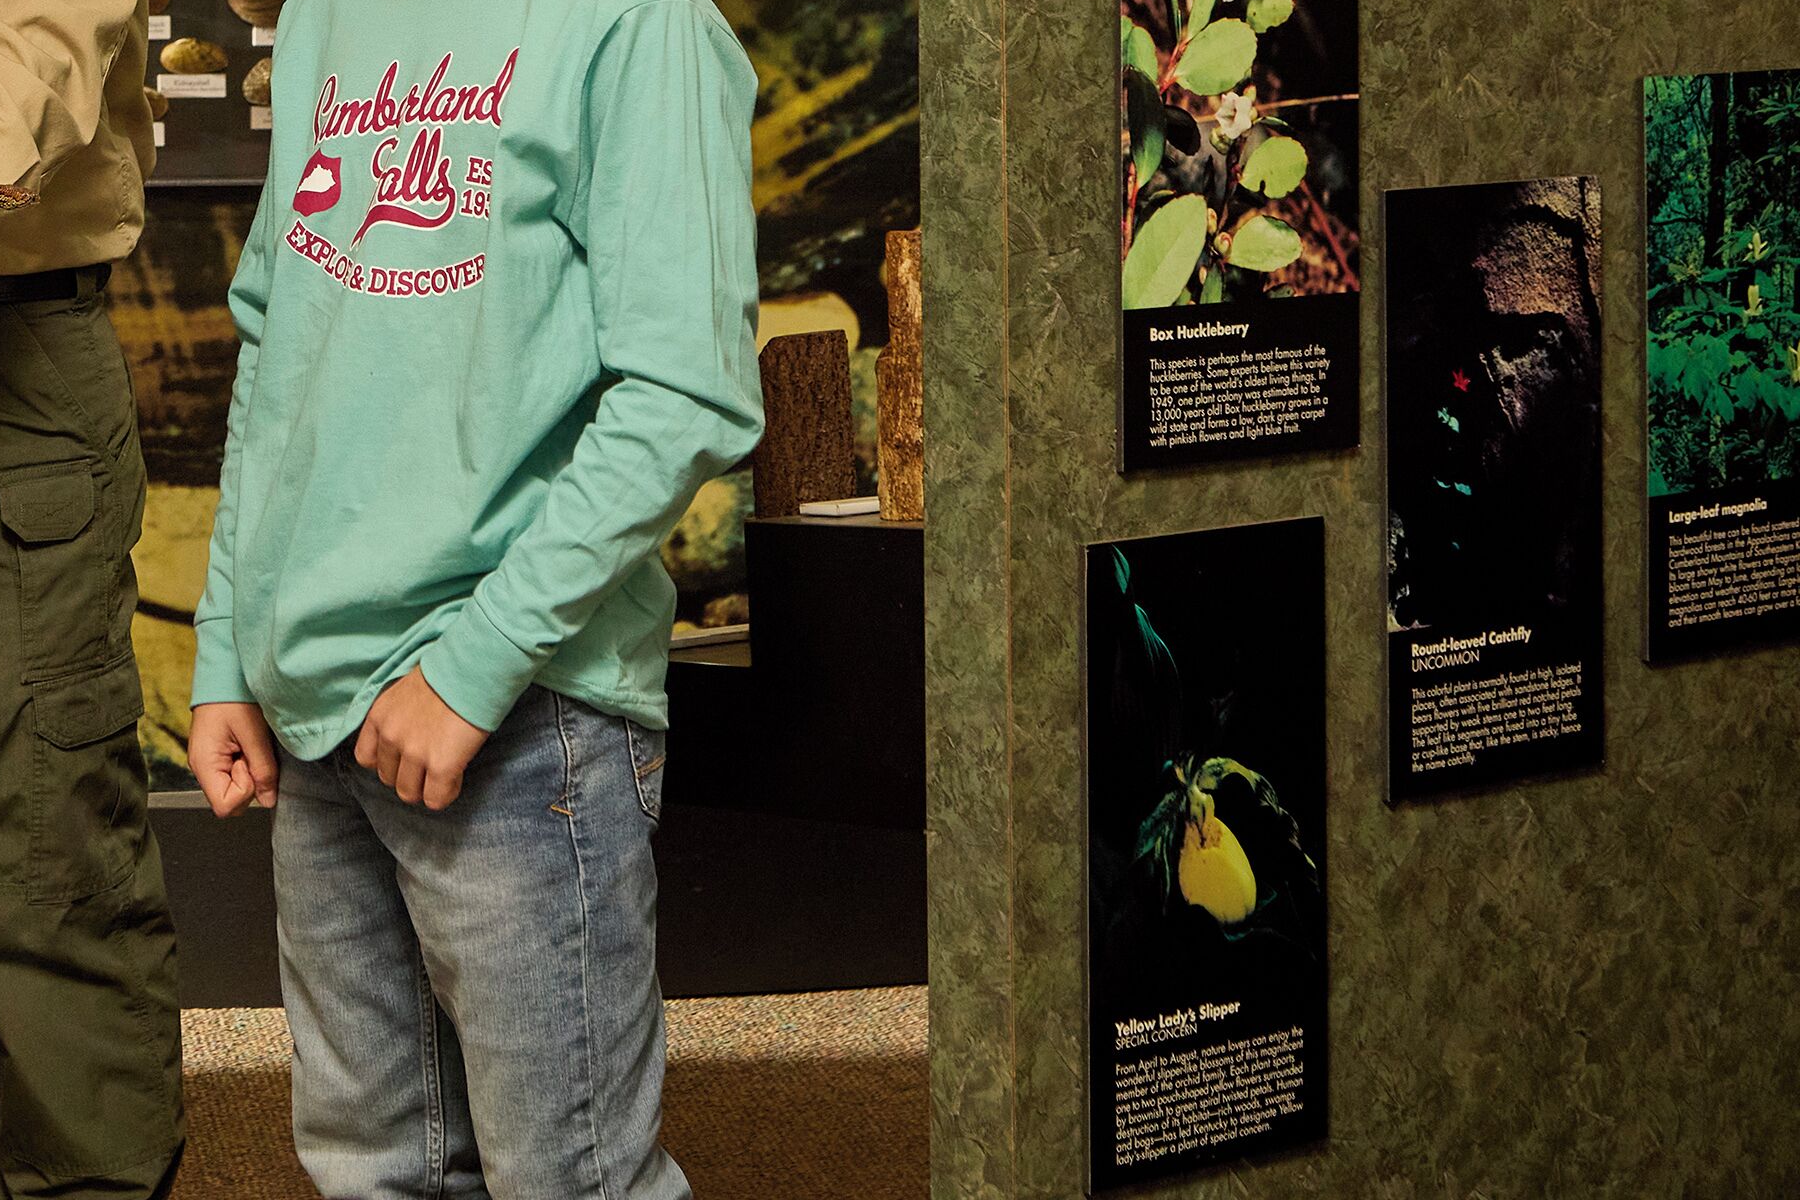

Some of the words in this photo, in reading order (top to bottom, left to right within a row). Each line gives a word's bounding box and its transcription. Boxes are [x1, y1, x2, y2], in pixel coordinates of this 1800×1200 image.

[313, 46, 520, 146] Cumbrland
[465, 155, 492, 187] ES
[460, 189, 490, 220] 19
[285, 218, 353, 288] EXPLO
[348, 264, 365, 293] &
[366, 252, 486, 298] DISCOVER
[1150, 328, 1174, 341] Box
[1177, 322, 1250, 340] Huckleberry
[1150, 358, 1166, 370] This
[1167, 357, 1197, 371] species
[1198, 356, 1206, 366] is
[1207, 353, 1240, 368] perhaps
[1240, 351, 1254, 363] the
[1254, 350, 1274, 361] most
[1274, 348, 1302, 360] famous
[1303, 345, 1312, 357] of
[1313, 345, 1326, 357] the
[1669, 503, 1720, 524] Large-leaf
[1722, 498, 1767, 516] magnolia
[1412, 632, 1486, 657] Round-leaved
[1489, 626, 1532, 646] Catchfly
[1412, 650, 1480, 672] UNCOMMON
[1115, 1018, 1156, 1037] Yellow
[1159, 1008, 1196, 1028] Lady's
[1200, 1002, 1240, 1021] Slipper
[1116, 1034, 1149, 1050] SPECIAL
[1152, 1023, 1198, 1042] CONCERN
[1116, 1064, 1136, 1076] From
[1138, 1056, 1158, 1073] April
[1159, 1056, 1168, 1067] to
[1169, 1049, 1199, 1066] August,
[1201, 1045, 1226, 1058] nature
[1227, 1040, 1250, 1052] lovers
[1251, 1037, 1266, 1047] can
[1268, 1032, 1290, 1045] enjoy
[1291, 1026, 1303, 1039] the
